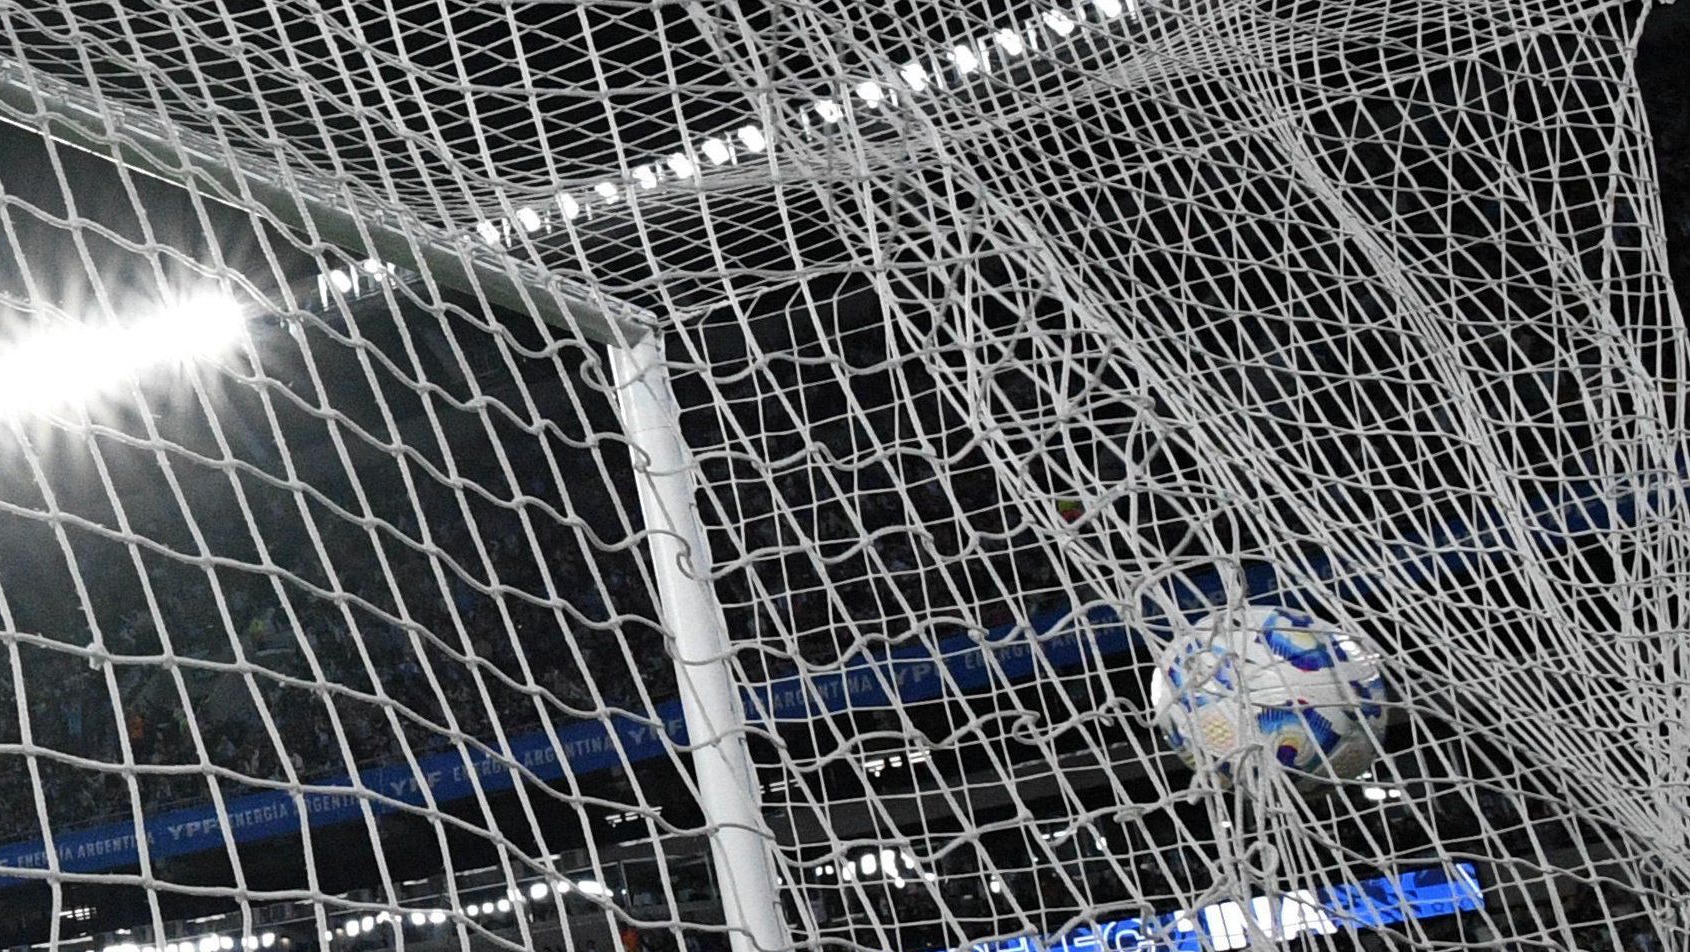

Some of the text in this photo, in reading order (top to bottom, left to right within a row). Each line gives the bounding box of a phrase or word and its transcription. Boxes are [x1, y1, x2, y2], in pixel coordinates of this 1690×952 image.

[774, 673, 874, 710] ARNTNA
[18, 843, 74, 869] ENEÍA
[78, 830, 156, 859] ARGENTIA
[167, 817, 222, 842] YPF
[523, 736, 615, 768] ARGNTINA
[628, 717, 687, 746] YF
